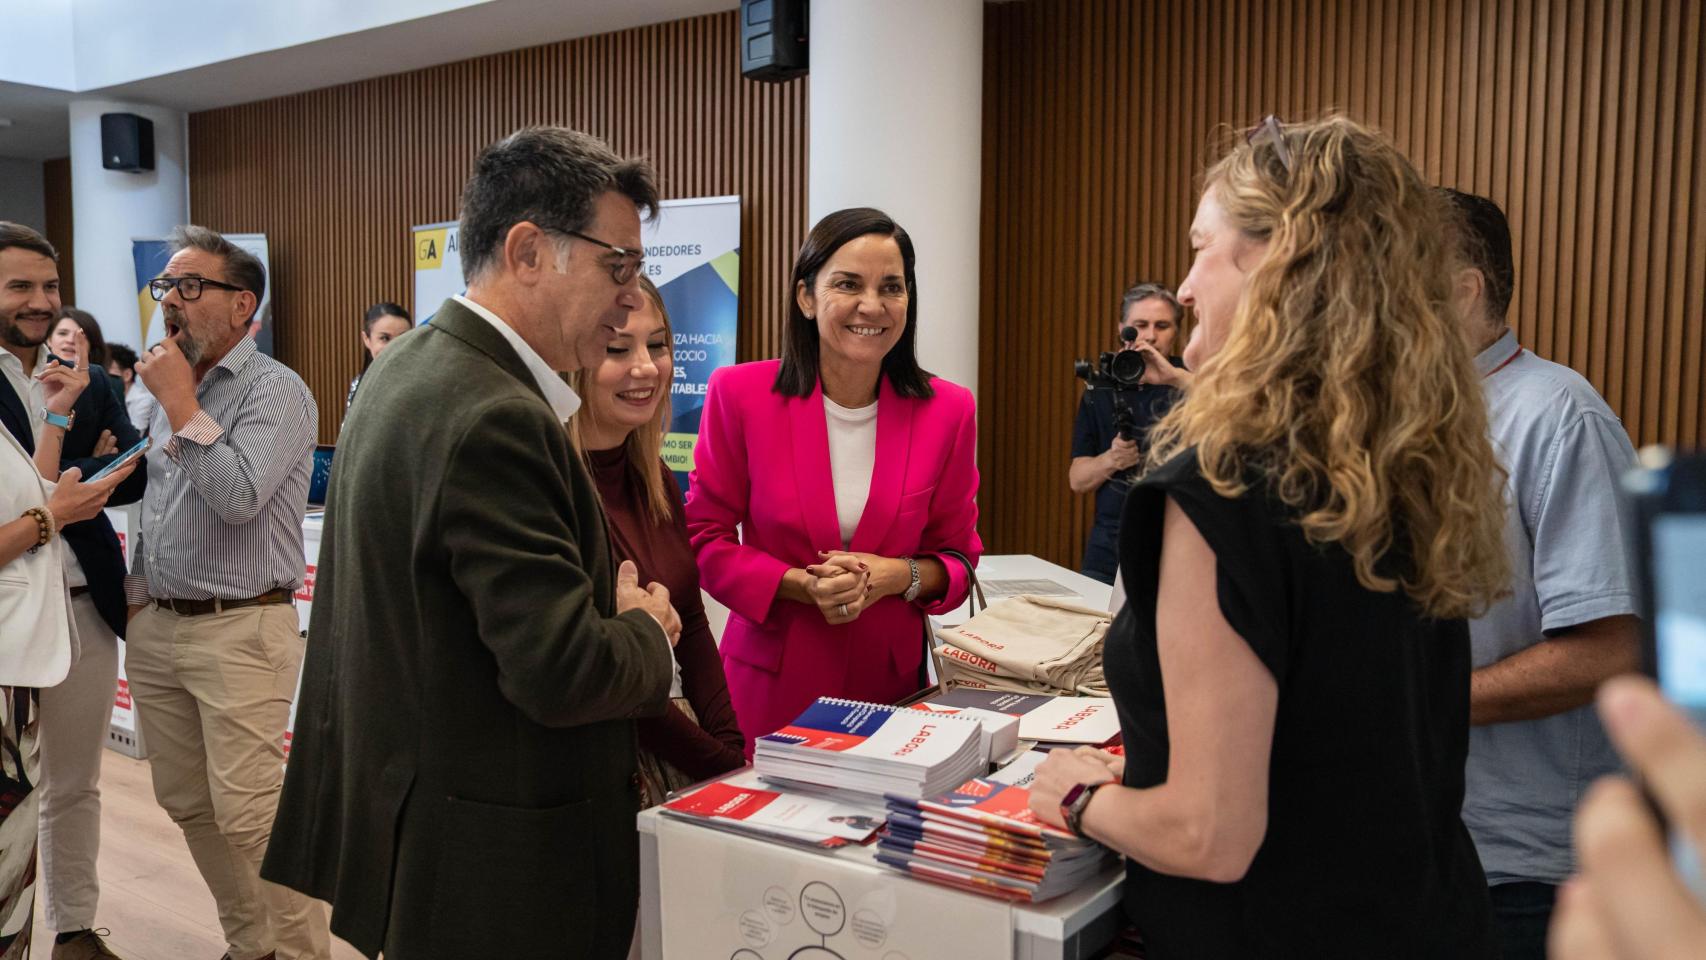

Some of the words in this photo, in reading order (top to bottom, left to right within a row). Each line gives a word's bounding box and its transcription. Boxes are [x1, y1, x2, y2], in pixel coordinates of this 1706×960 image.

[689, 333, 722, 345] HACIA
[673, 350, 707, 362] GOCIO
[678, 440, 693, 449] SER
[943, 647, 997, 673] LABORA
[1052, 705, 1105, 730] LABORA
